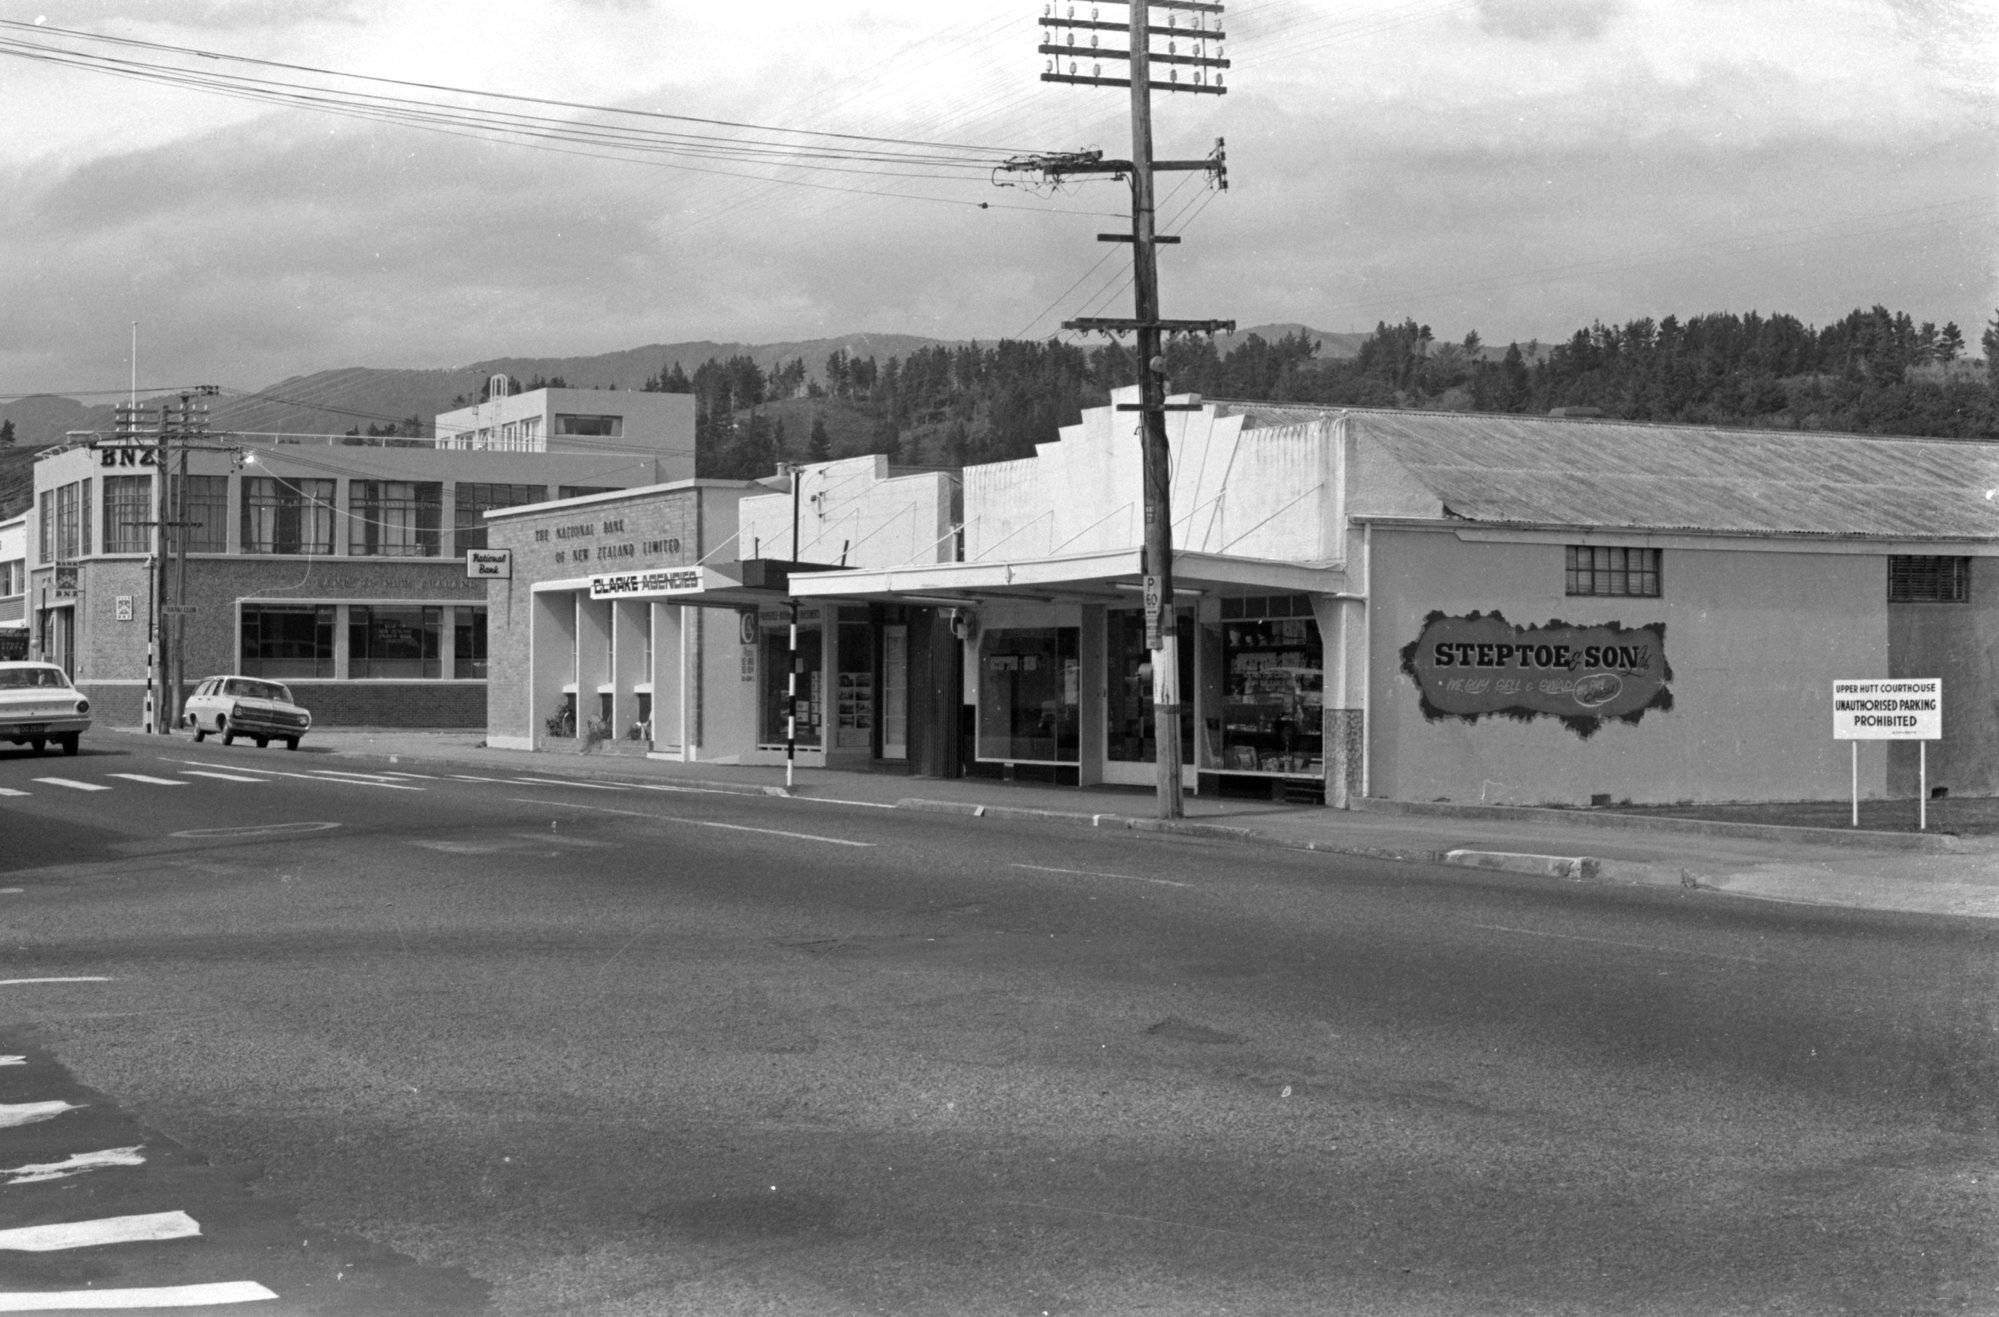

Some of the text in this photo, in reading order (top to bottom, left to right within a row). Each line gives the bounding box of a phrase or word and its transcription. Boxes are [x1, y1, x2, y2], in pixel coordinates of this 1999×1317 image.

[101, 446, 157, 467] BNZ
[535, 519, 624, 542] THE NATIONAL BANK
[473, 552, 507, 563] National
[555, 538, 680, 563] OF NEW ZEALAND LIMITED
[479, 563, 499, 574] Bank
[593, 571, 699, 594] CLARKE AGENCIES
[1147, 577, 1155, 592] P
[1146, 593, 1158, 606] 60
[1434, 643, 1570, 669] STEPTOE
[1584, 646, 1639, 669] SON
[1496, 679, 1521, 694] SELL
[1539, 679, 1573, 694] SWAP
[1836, 683, 1936, 693] UPPER HUTT COURTHOUSE
[1835, 699, 1936, 711] UNAUTHORISED PARKING
[1854, 715, 1917, 726] PROHIBITED
